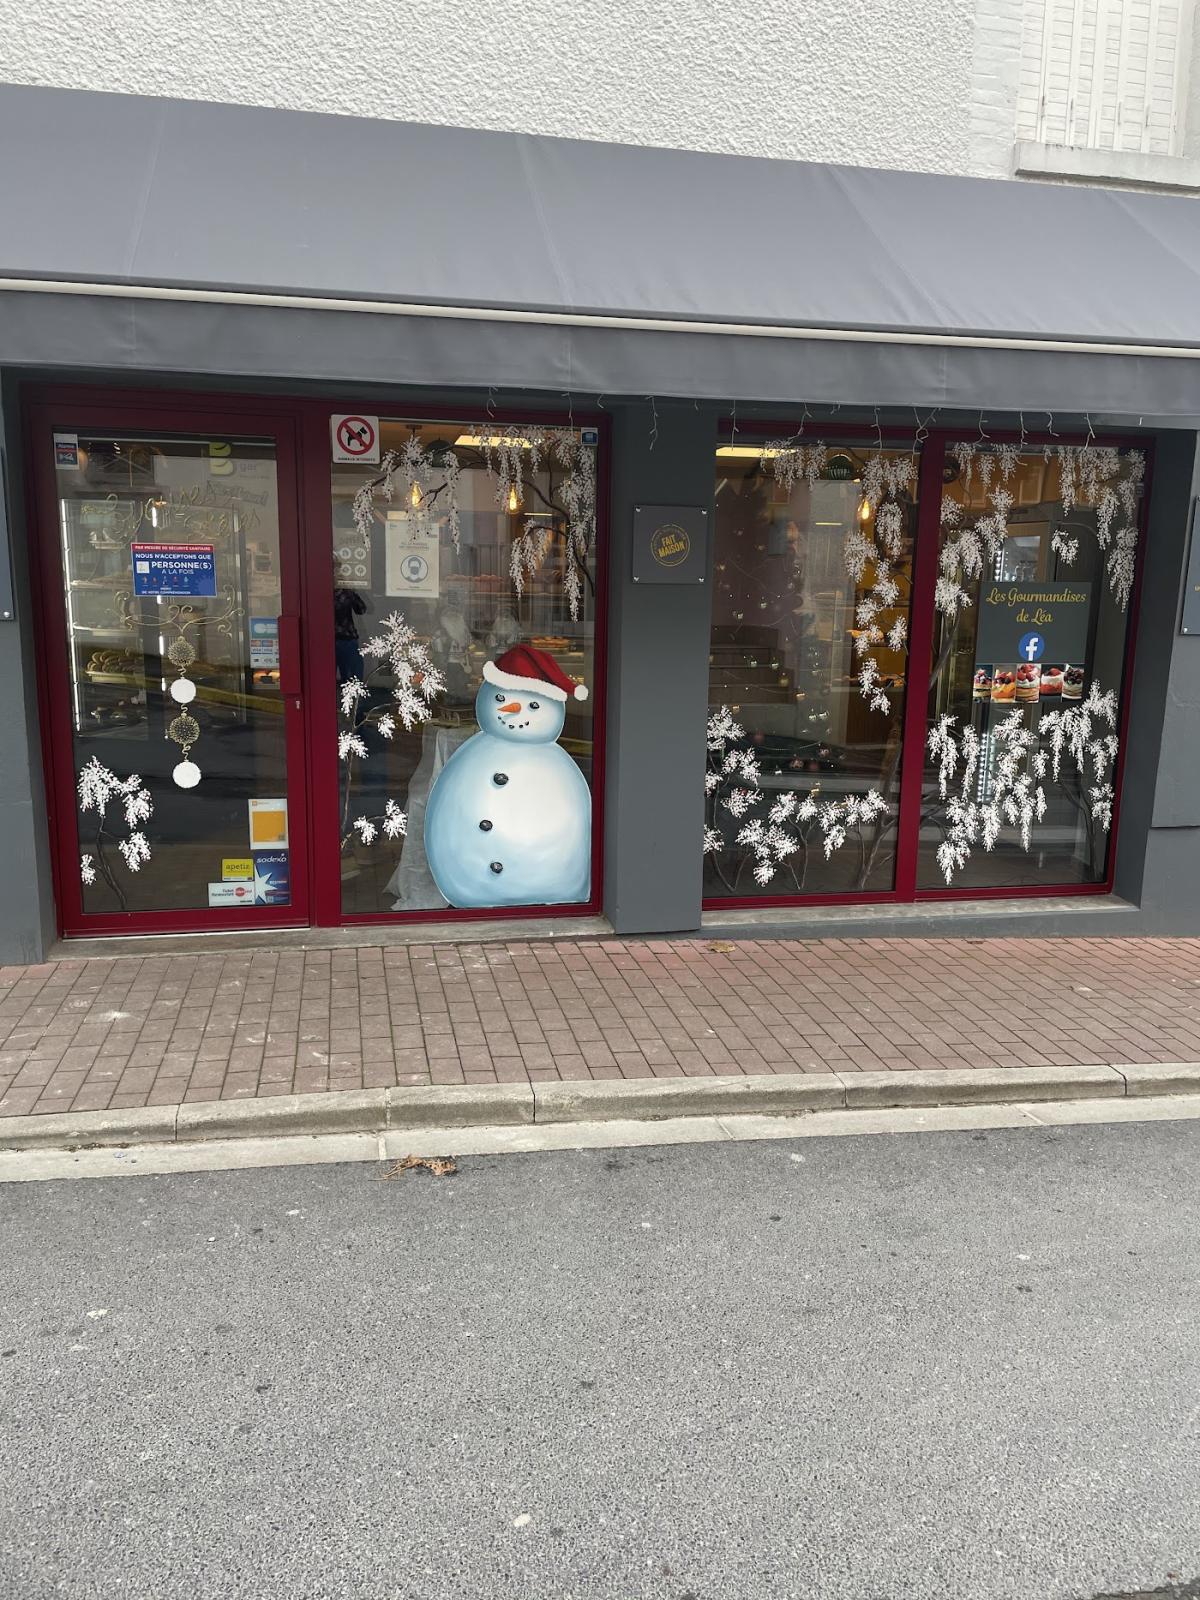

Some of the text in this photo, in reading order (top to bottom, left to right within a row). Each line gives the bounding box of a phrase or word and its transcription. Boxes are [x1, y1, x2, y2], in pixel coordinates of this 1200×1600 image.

[661, 534, 676, 547] FAIT
[658, 540, 685, 558] MAISON
[151, 561, 212, 570] PERSONNE(S)
[986, 587, 1087, 607] Les Gourmandises
[1016, 607, 1053, 625] de Léa
[256, 853, 287, 864] sodexo
[225, 862, 250, 871] apetiz
